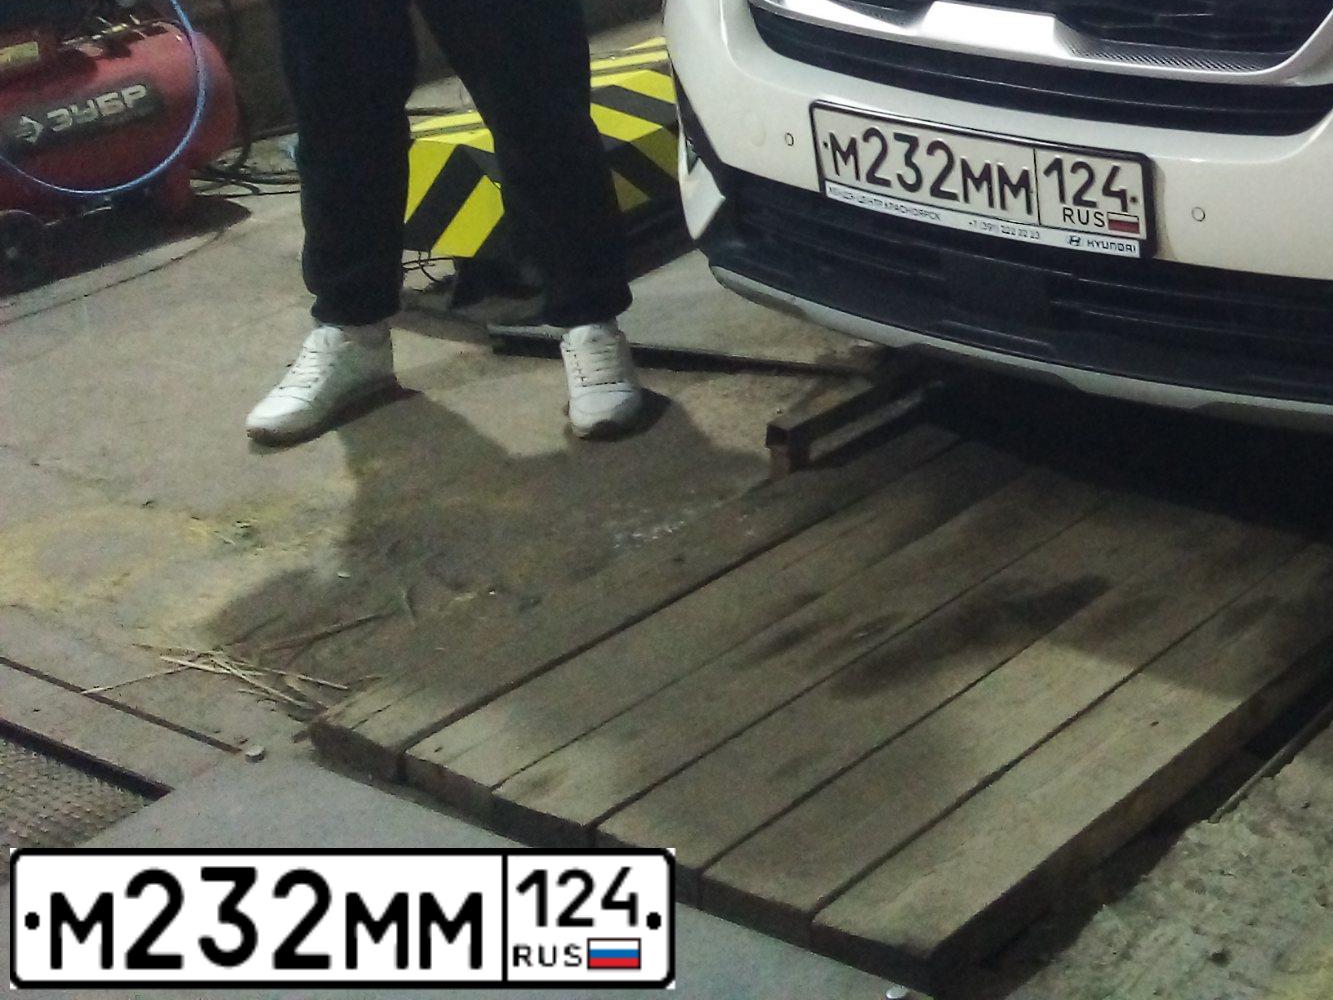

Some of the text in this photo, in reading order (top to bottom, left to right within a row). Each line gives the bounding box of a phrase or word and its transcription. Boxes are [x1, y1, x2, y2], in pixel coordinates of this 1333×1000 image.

[47, 84, 147, 133] ЗУБР
[1043, 157, 1129, 213] 124
[1062, 207, 1105, 228] RUS
[1086, 239, 1136, 253] HYUNDAI
